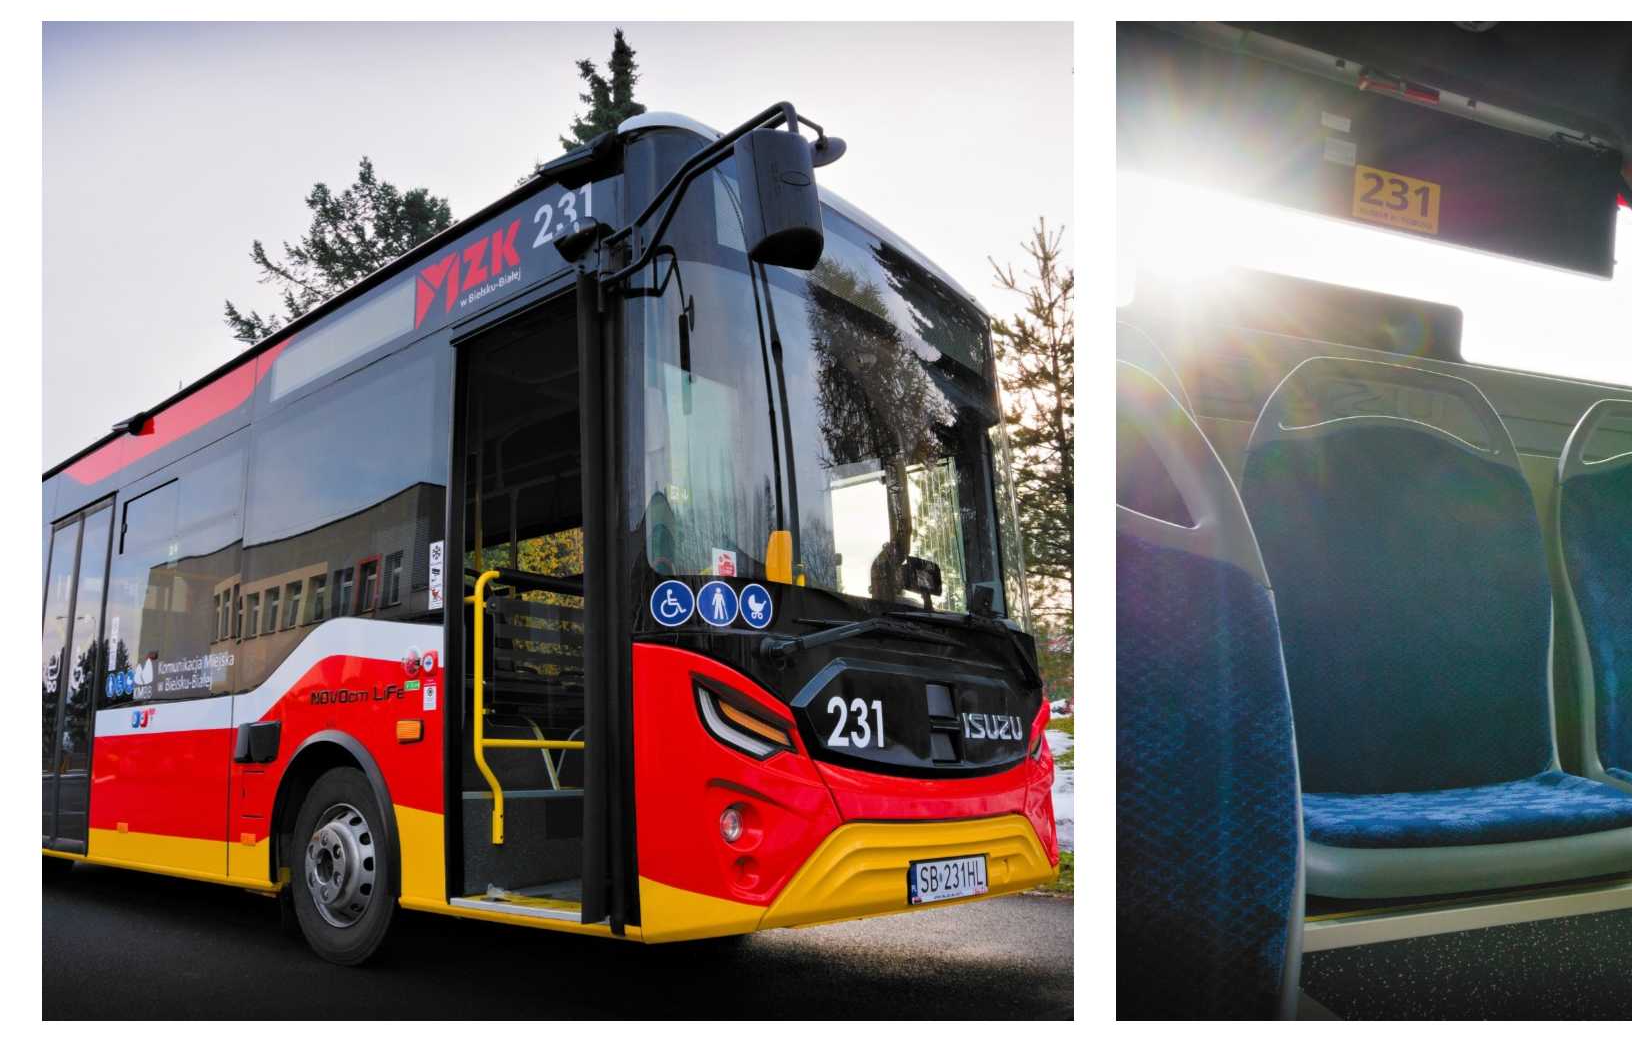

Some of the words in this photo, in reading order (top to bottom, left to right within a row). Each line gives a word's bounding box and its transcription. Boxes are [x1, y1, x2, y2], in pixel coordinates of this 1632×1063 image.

[532, 181, 592, 249] 231
[1360, 172, 1431, 218] 231
[415, 218, 521, 330] MZK
[827, 696, 885, 748] 231
[962, 712, 1023, 740] ISUZU
